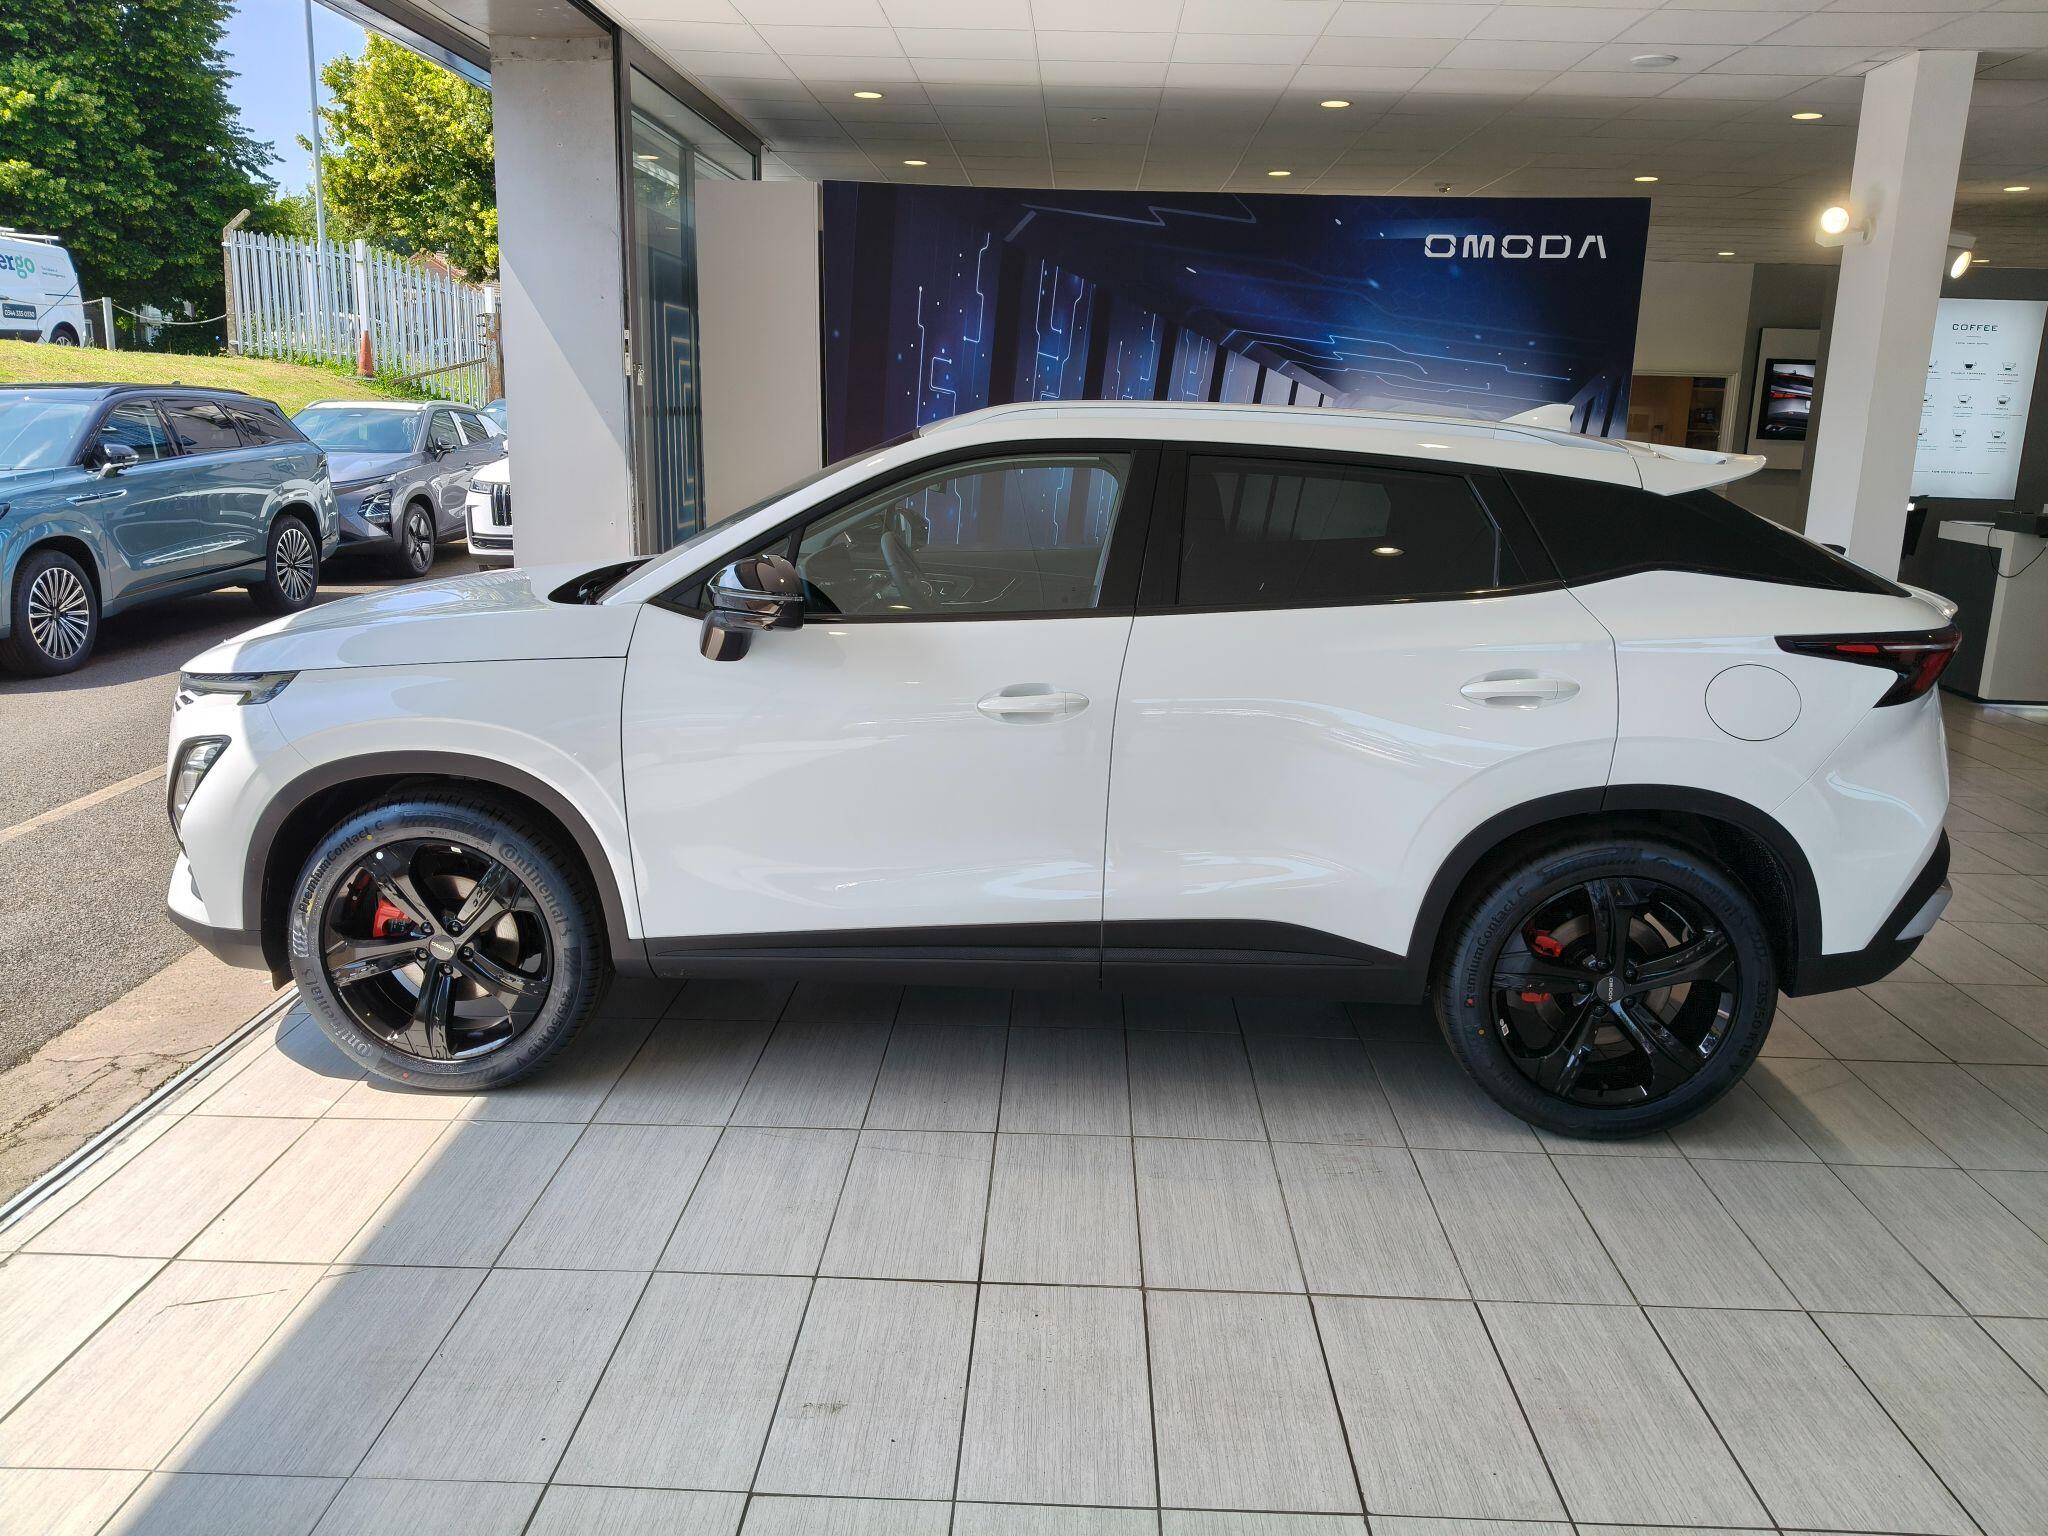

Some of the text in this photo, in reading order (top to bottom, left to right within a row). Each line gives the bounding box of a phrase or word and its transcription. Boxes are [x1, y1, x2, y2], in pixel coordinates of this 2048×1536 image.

[1424, 234, 1607, 259] OMODA
[1952, 323, 1999, 332] COFFEE
[297, 826, 370, 913] PremiumContact
[499, 843, 569, 924] Continental
